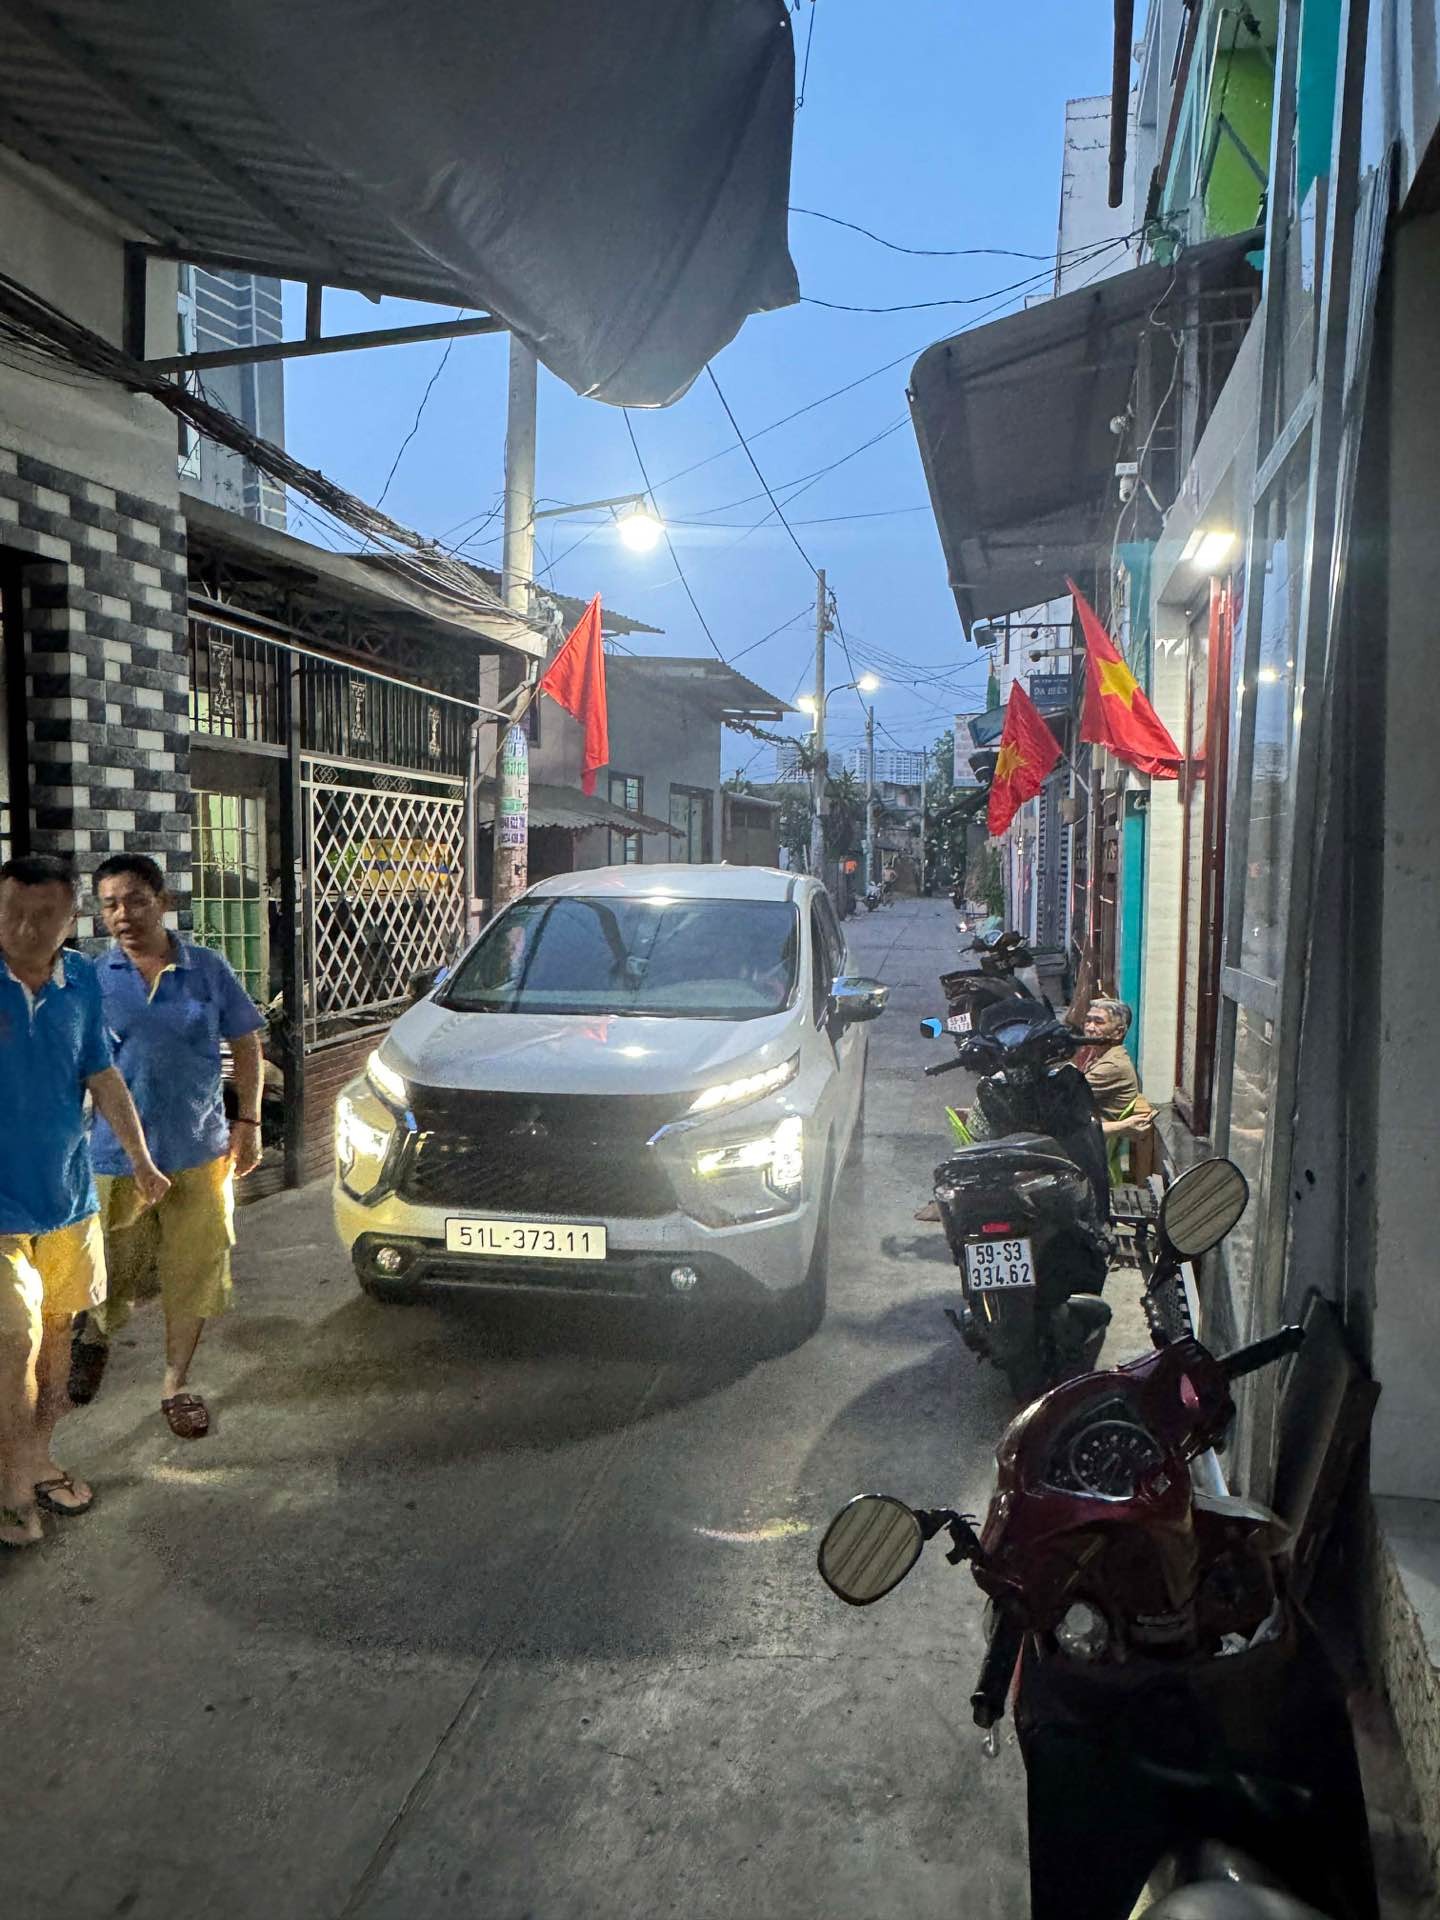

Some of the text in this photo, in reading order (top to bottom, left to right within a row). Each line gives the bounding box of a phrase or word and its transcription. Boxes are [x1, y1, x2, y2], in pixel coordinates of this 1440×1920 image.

[460, 1226, 590, 1254] 51L-373.11
[975, 1241, 1022, 1265] 59-S3
[972, 1263, 1031, 1288] 334.62
